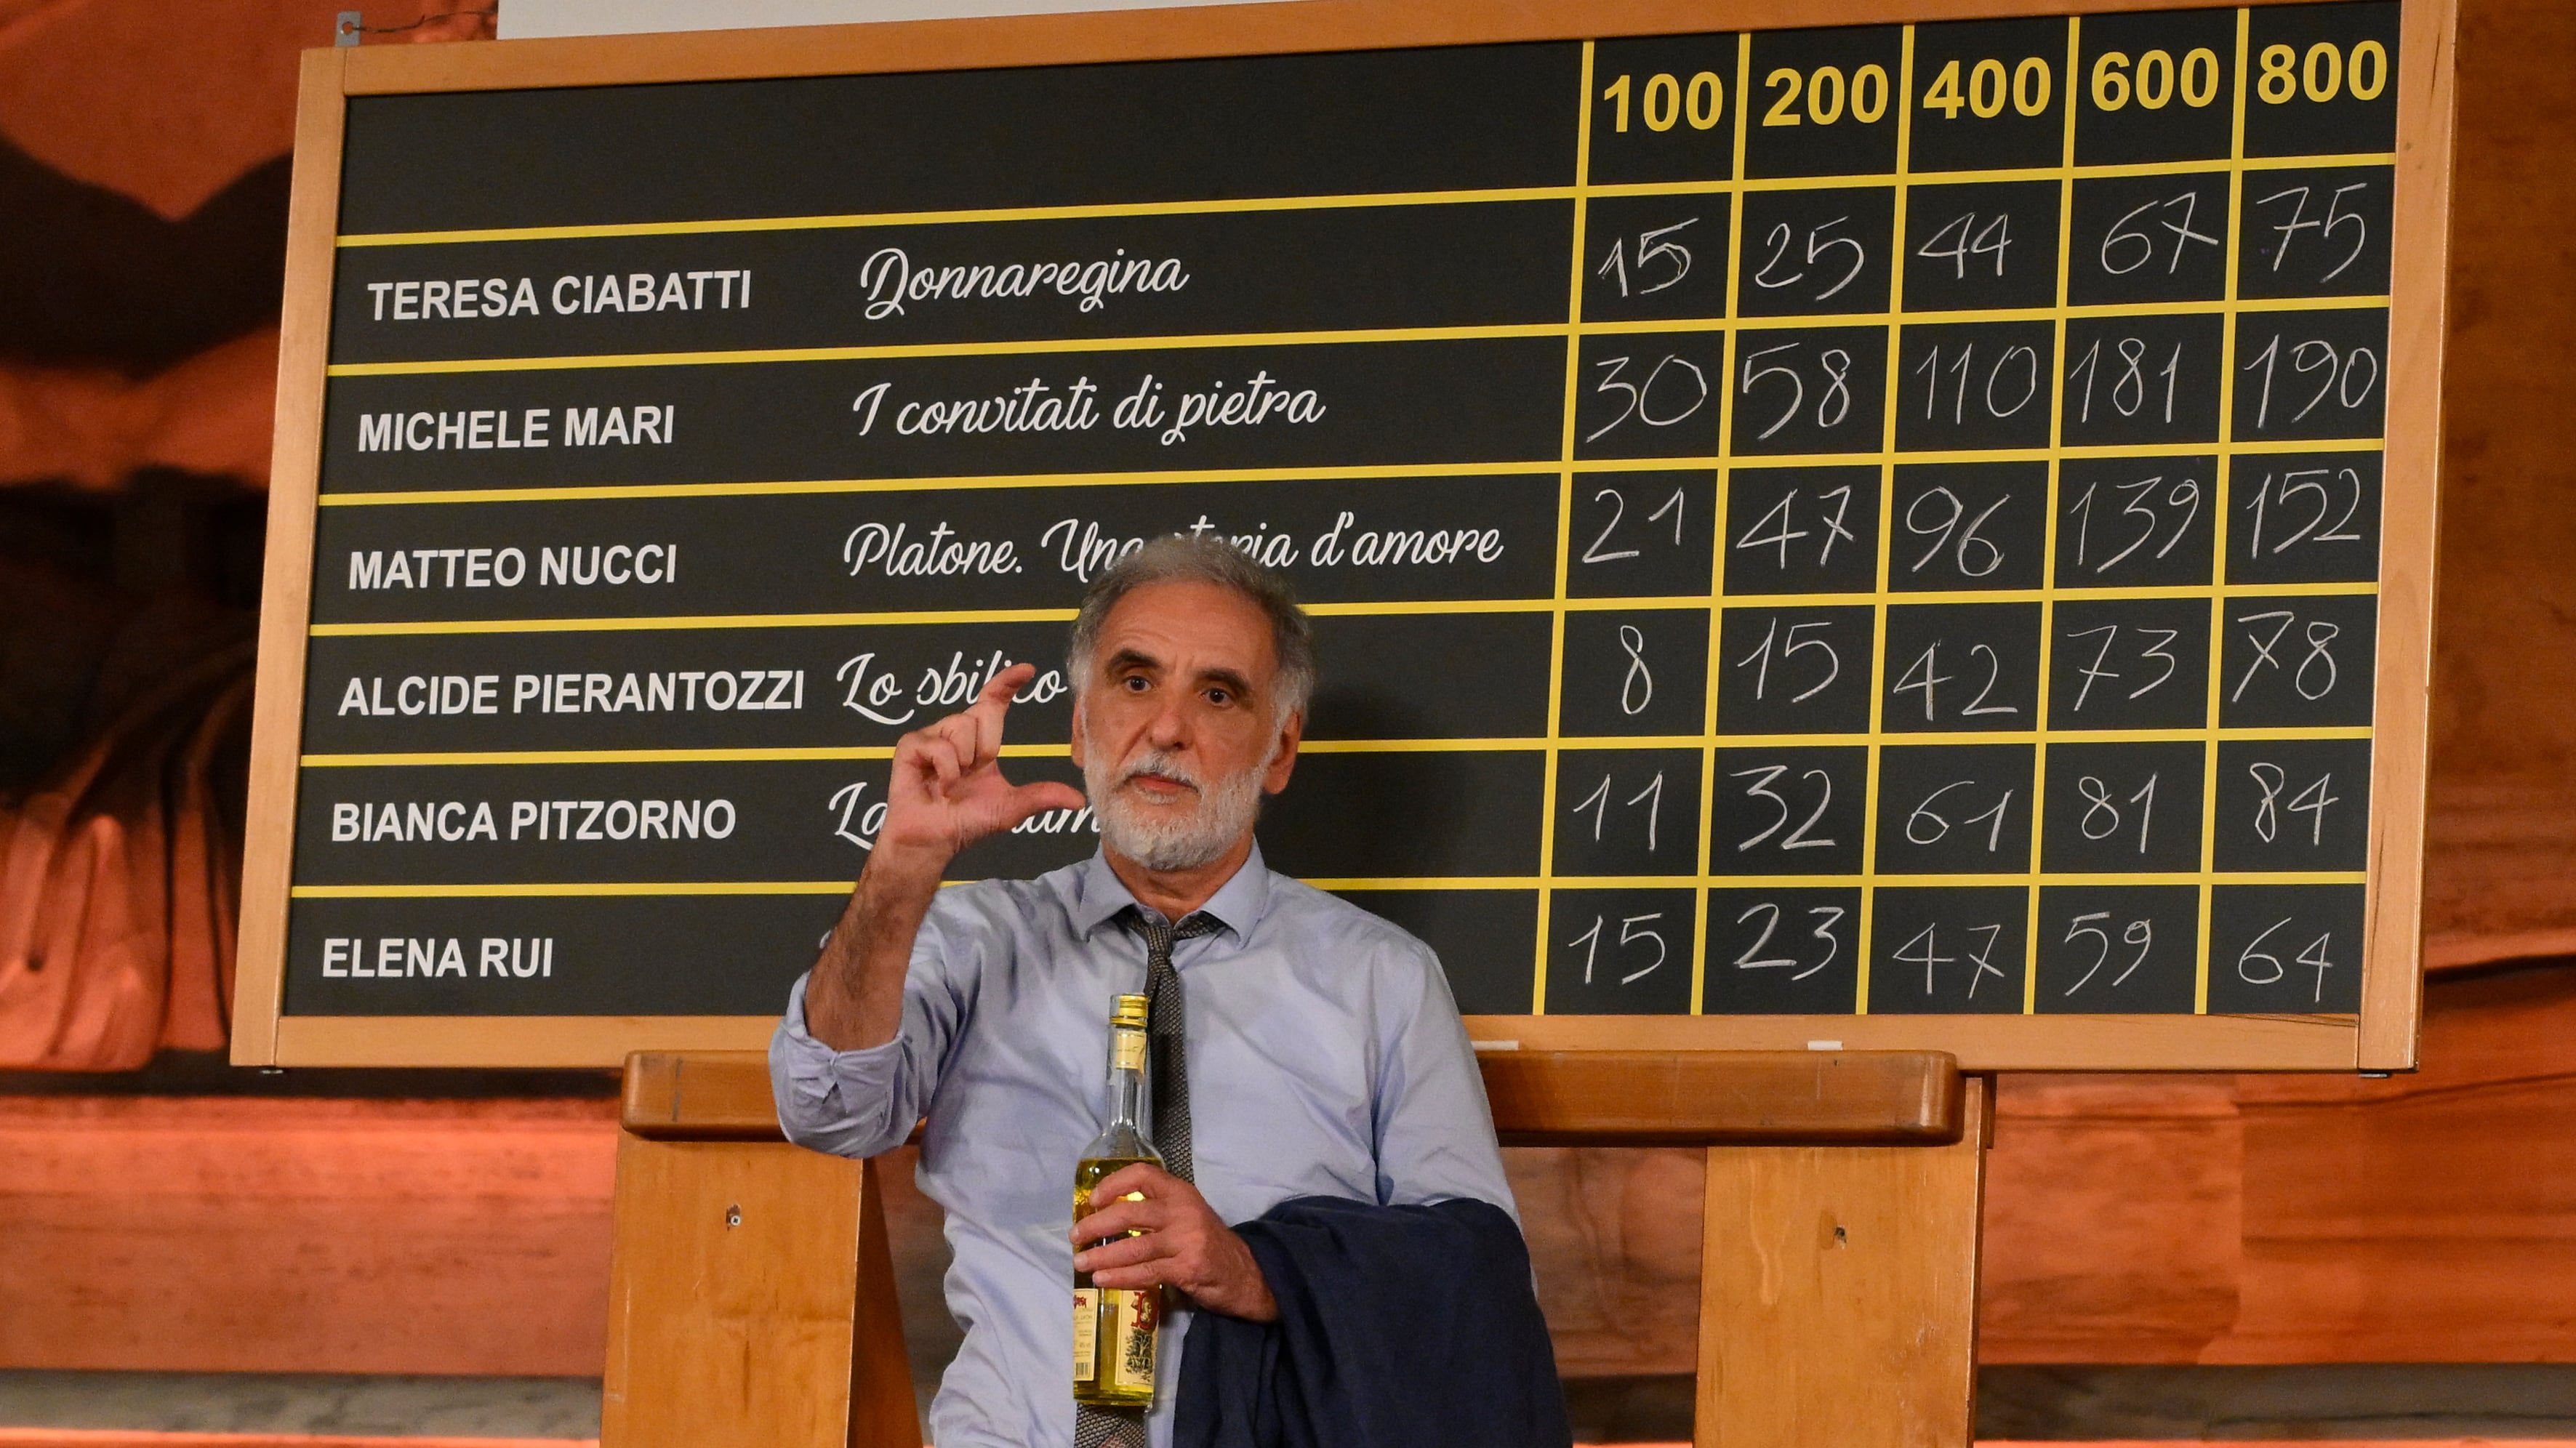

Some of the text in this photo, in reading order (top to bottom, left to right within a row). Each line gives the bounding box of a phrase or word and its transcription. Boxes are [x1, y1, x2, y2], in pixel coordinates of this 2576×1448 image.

[1605, 41, 2387, 132] 100 200 400 600 800
[1598, 183, 2367, 300] 15 25 44 67 75
[368, 270, 750, 321] TERESA CIABATTI
[861, 249, 1189, 319] Donnaregina
[853, 371, 1326, 446] I convitati di pietra
[1586, 334, 2377, 443] 30 58 110 181 190
[358, 406, 674, 451] MICHELE MARI
[844, 522, 1022, 576] Platone.
[1311, 512, 1504, 566] d'amore
[1582, 468, 2360, 576] 21 47 96 139 152
[349, 544, 676, 590] MATTEO NUCCI
[338, 670, 803, 715] ALCIDE PIERANTOZZI
[837, 653, 914, 725] Lo
[1621, 611, 2339, 721] 8 15 42 73 78
[332, 800, 736, 841] BIANCA PITZORNO
[1573, 763, 2339, 853] 11 32 61 81 84
[323, 938, 553, 978] ELENA RUI
[1568, 904, 2332, 1002] 15 23 47 59 64
